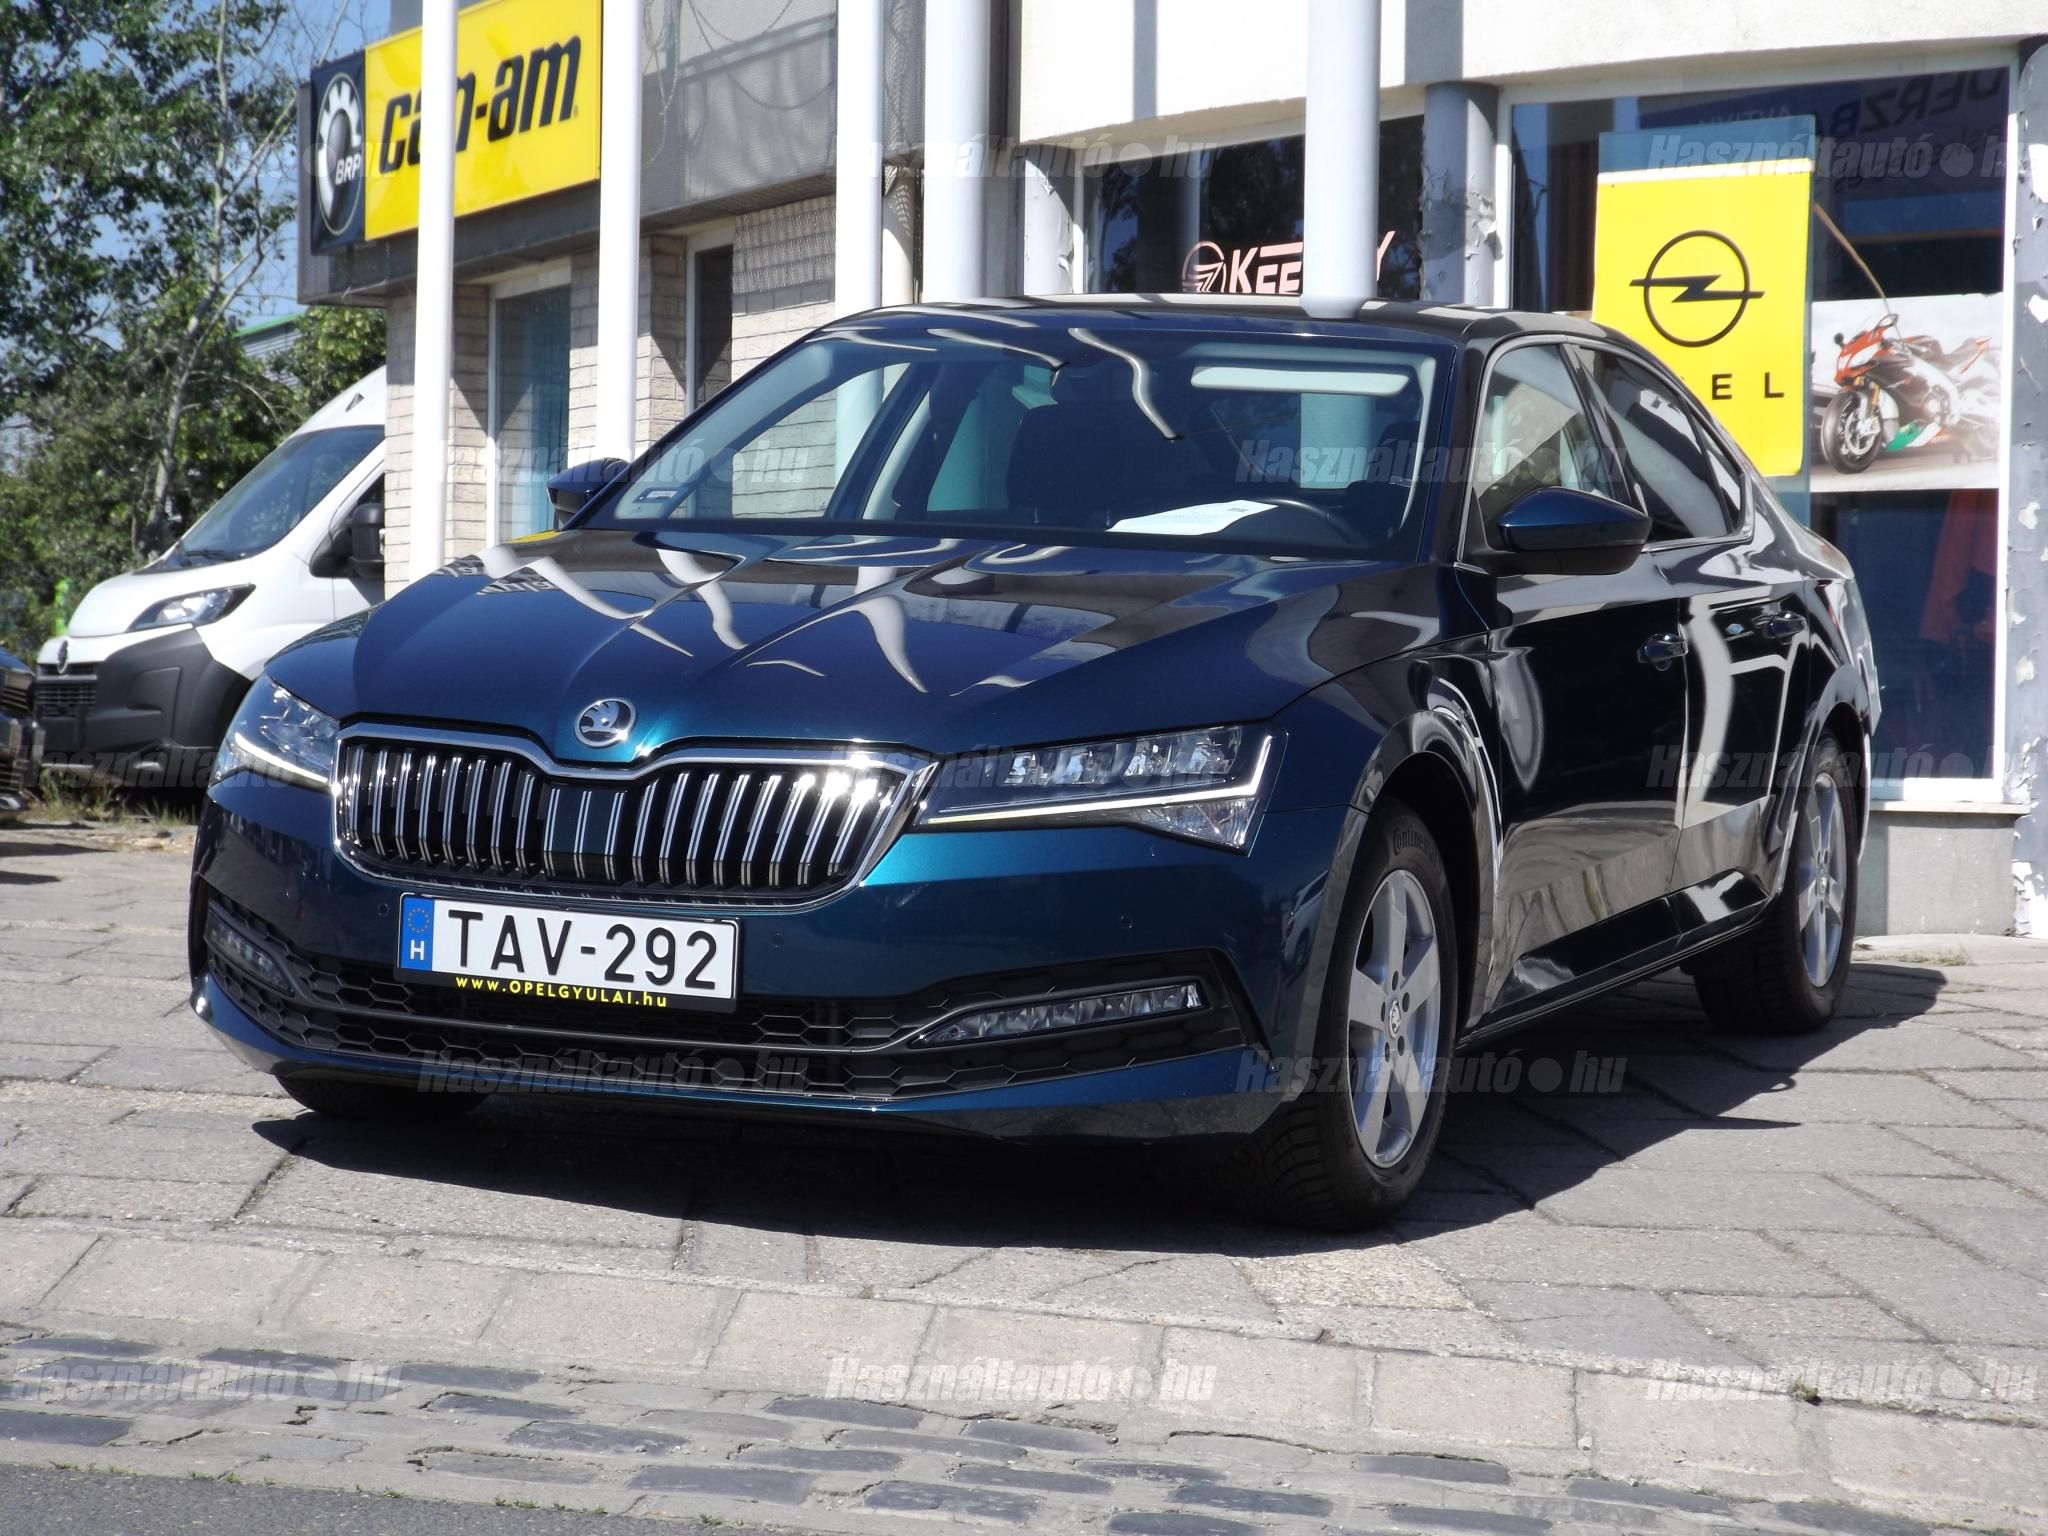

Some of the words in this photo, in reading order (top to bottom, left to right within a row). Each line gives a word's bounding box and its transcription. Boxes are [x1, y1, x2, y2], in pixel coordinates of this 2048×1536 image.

[335, 153, 361, 185] BRP
[1229, 231, 1396, 294] KEEY
[1711, 371, 1785, 400] EL
[410, 940, 425, 961] H
[448, 909, 717, 990] TAV-292
[456, 977, 667, 1007] www.OPELGYULAI.hu
